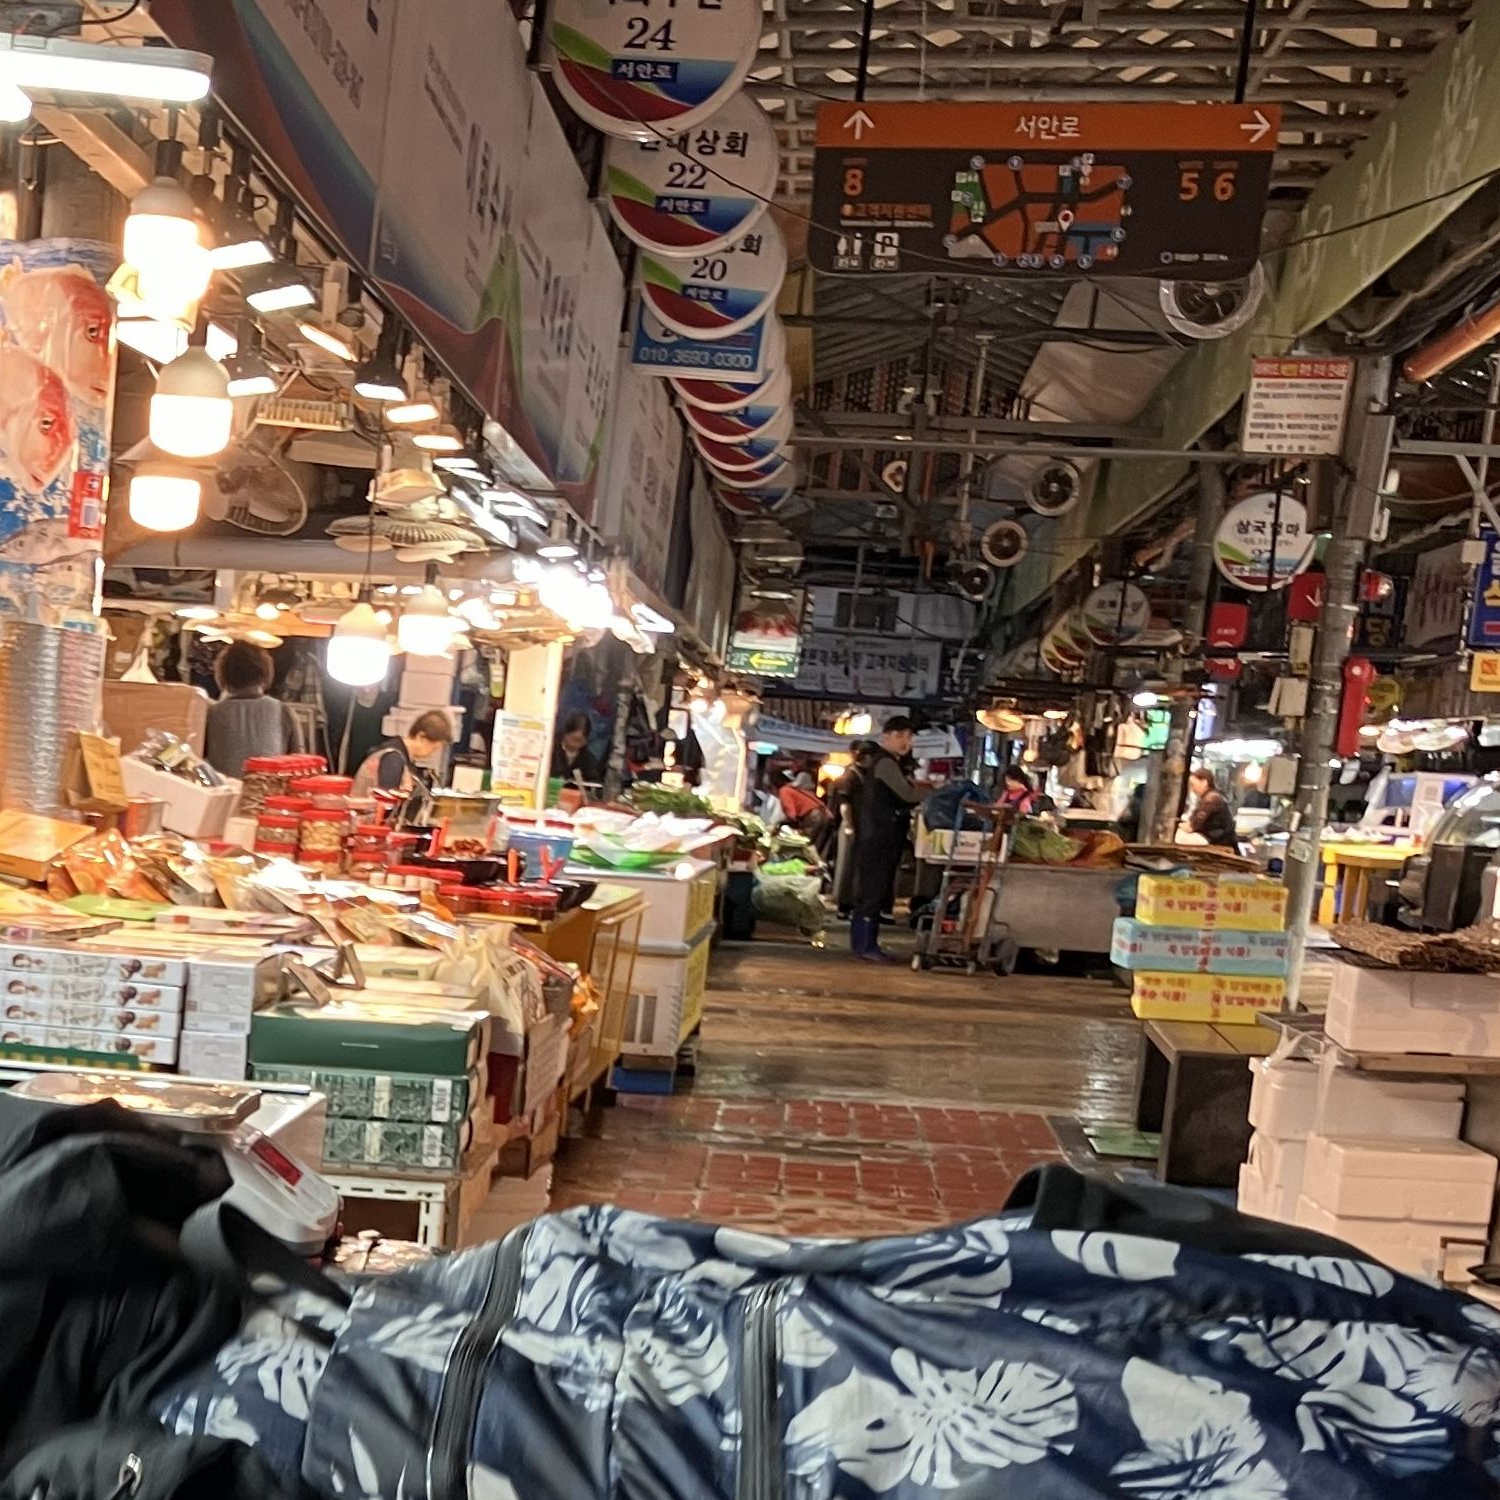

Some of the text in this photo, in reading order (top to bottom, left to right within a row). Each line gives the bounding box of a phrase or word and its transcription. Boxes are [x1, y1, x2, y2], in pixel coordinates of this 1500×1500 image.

[623, 16, 676, 50] 24
[616, 61, 673, 80] 서안로
[1015, 115, 1081, 140] 서안로
[665, 162, 708, 190] 22
[843, 168, 863, 197] 8
[1179, 171, 1236, 201] 5 6
[691, 257, 728, 281] 20
